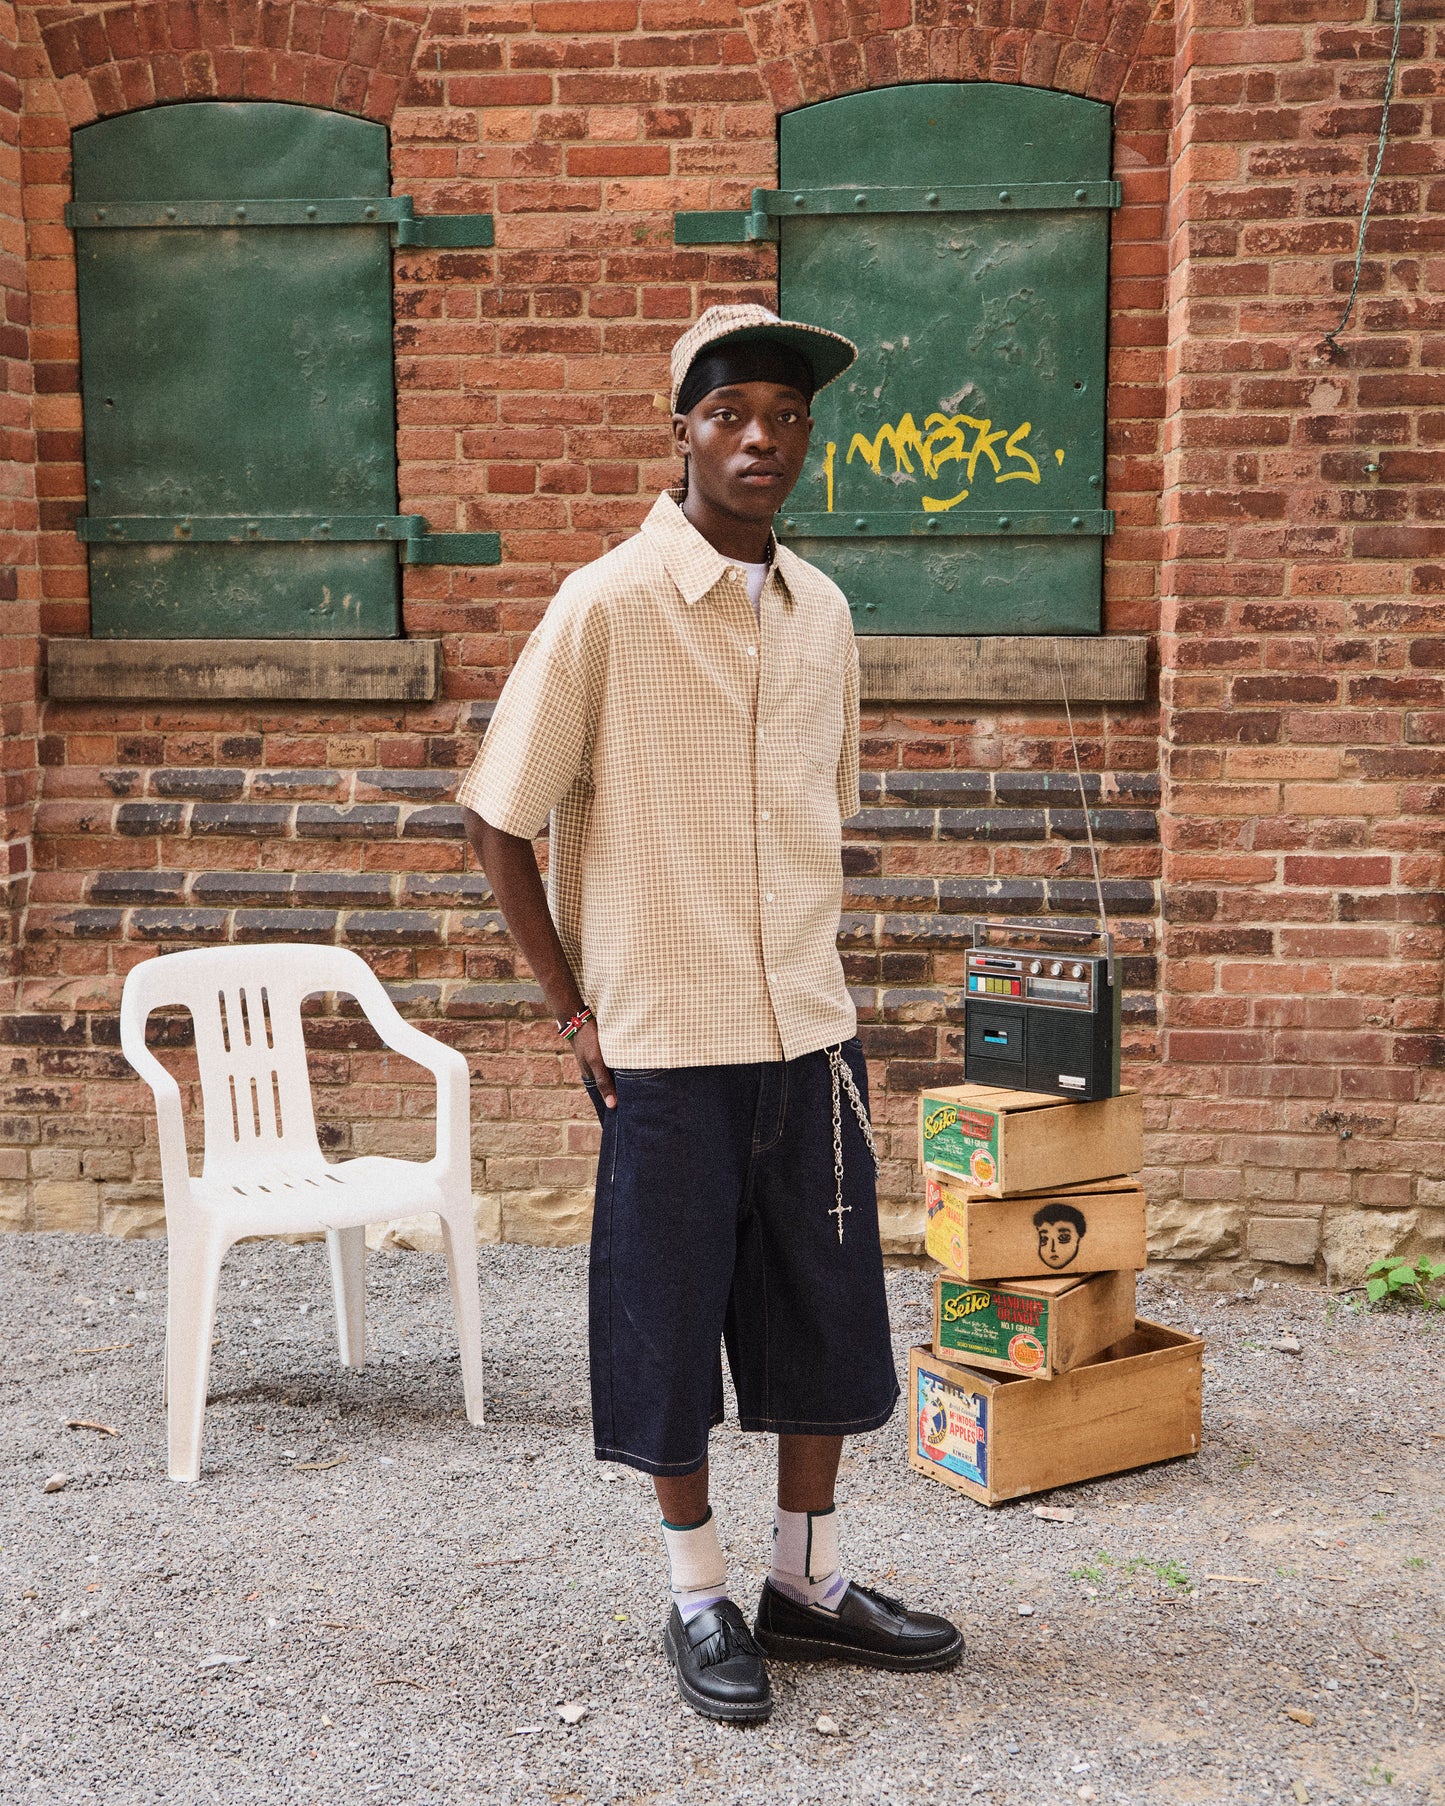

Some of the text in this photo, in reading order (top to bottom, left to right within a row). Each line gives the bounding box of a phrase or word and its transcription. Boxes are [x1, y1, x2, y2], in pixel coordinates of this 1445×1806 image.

[924, 1105, 957, 1140] Seiko
[944, 1290, 990, 1322] Seiko
[997, 1307, 1040, 1327] ORANGES
[1015, 1324, 1036, 1335] GRADE
[949, 1422, 976, 1445] APPLES
[952, 1448, 973, 1463] KIWANIS
